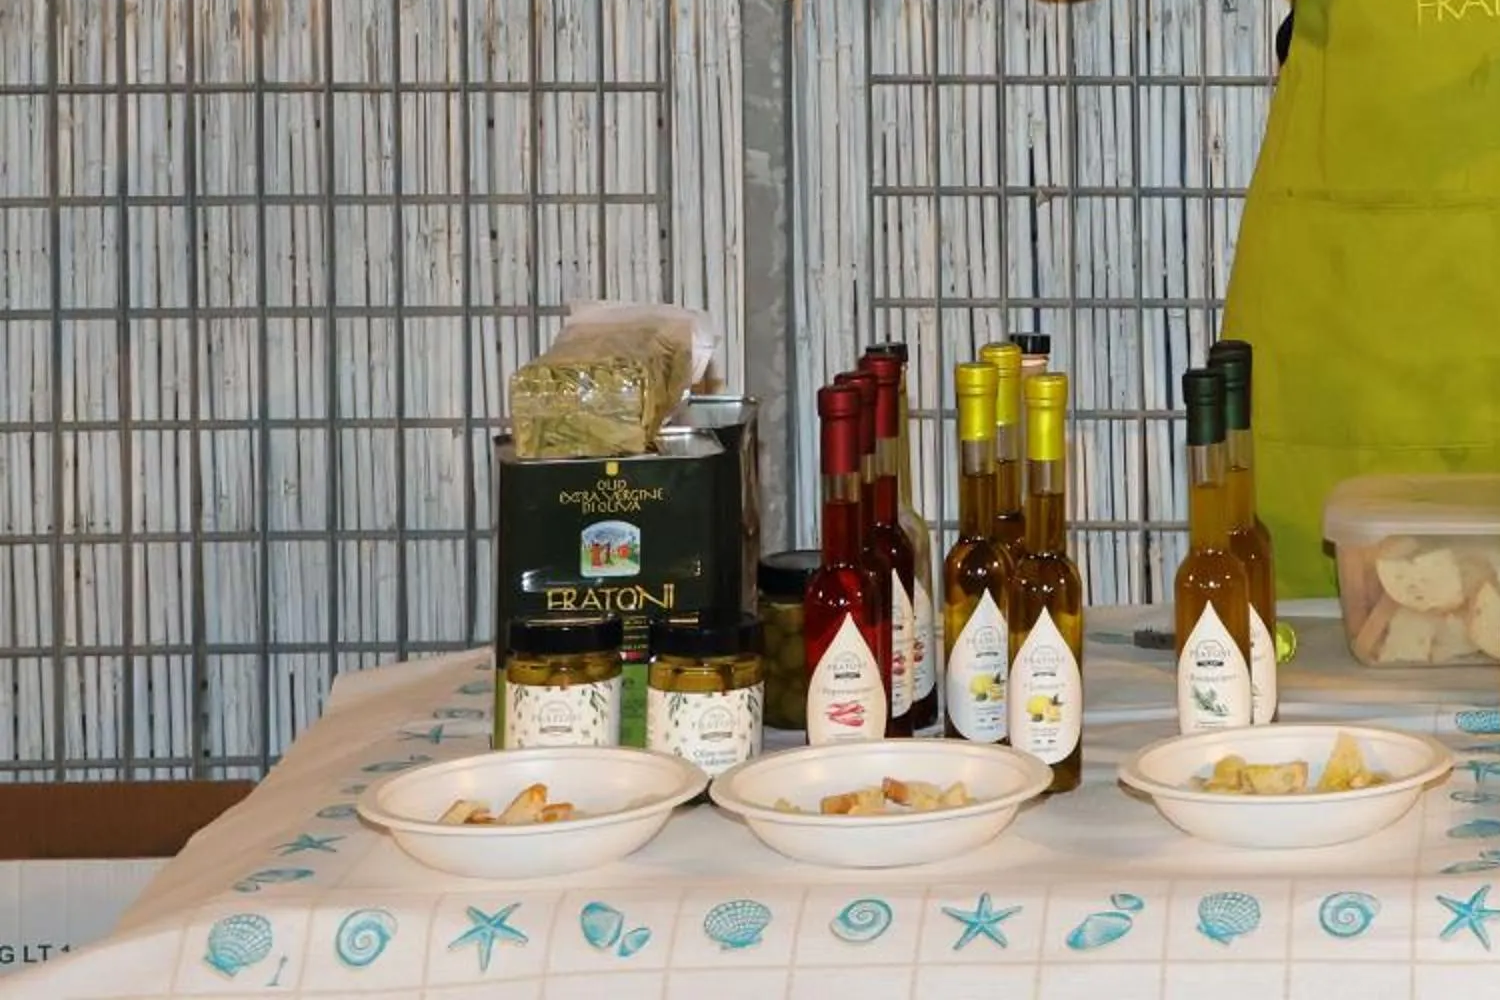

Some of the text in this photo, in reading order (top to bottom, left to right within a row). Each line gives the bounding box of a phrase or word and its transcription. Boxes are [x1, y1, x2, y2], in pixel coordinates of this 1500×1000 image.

[596, 479, 627, 491] OLIO
[602, 487, 664, 501] VERGINE
[599, 501, 642, 513] OLIVA
[546, 583, 675, 611] FRATONI
